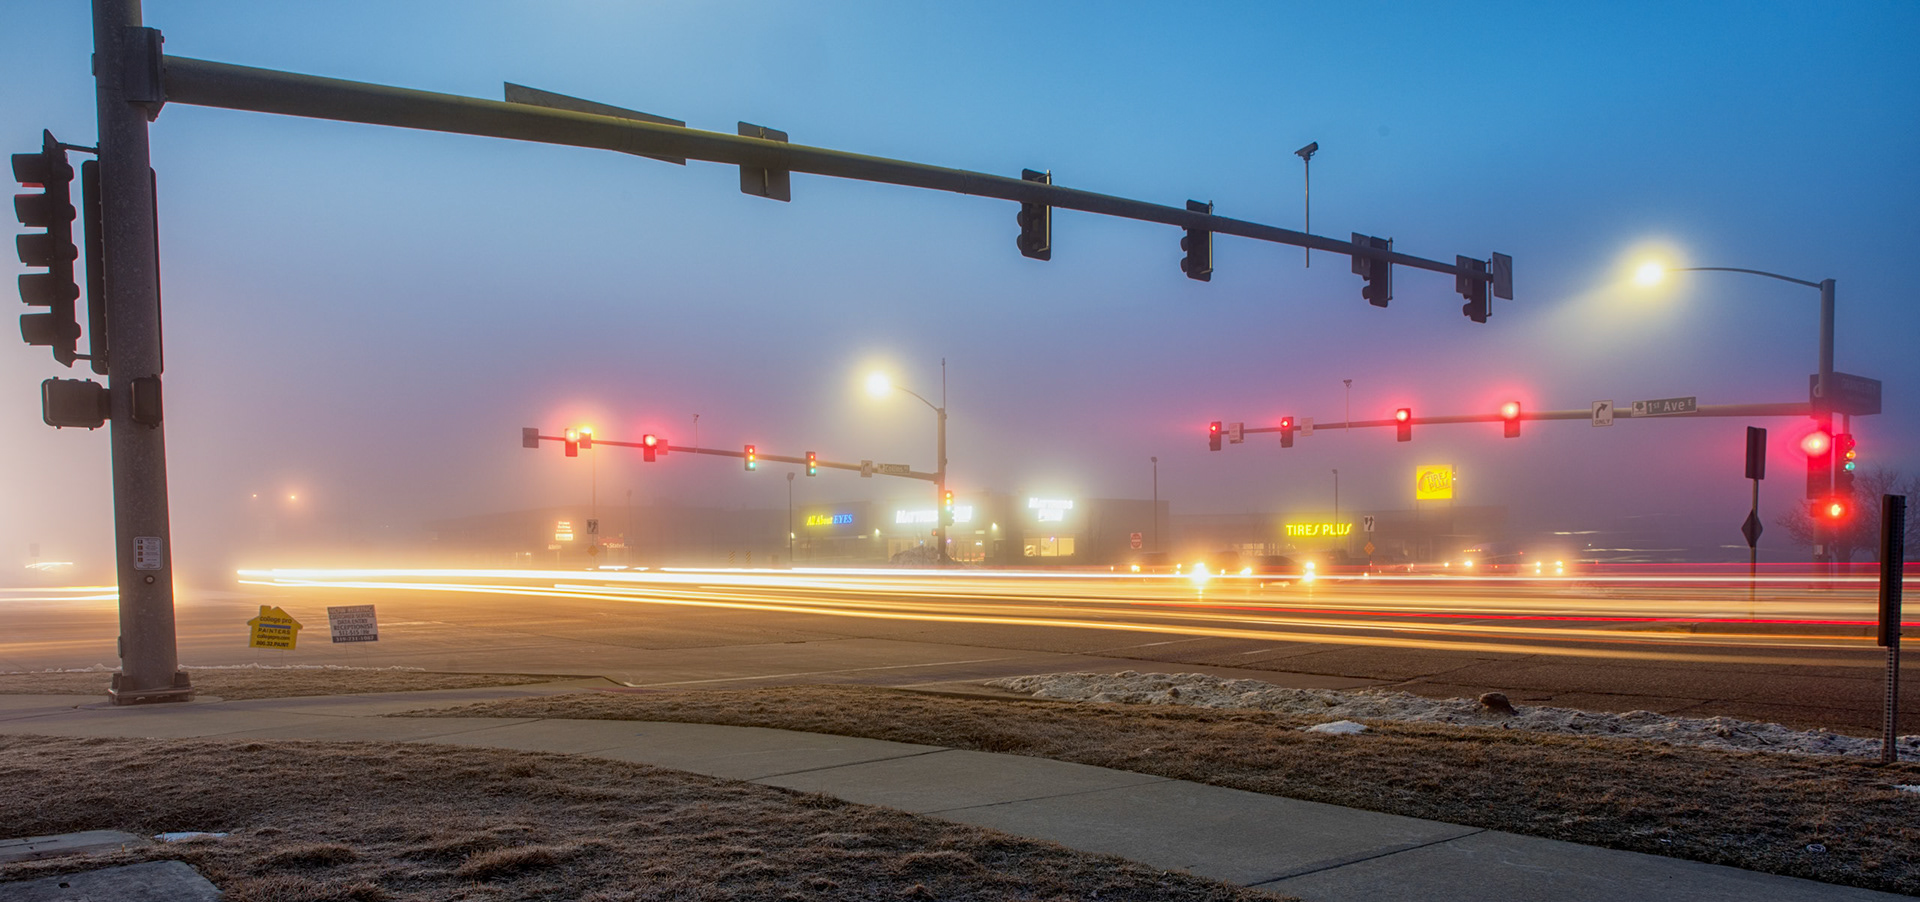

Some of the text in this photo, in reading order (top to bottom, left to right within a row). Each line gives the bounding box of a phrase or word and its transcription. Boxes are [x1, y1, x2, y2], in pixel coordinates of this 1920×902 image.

[1648, 401, 1660, 413] 1st
[1664, 401, 1685, 412] Ave
[1425, 471, 1449, 483] TIRES
[834, 514, 853, 524] EYES
[1286, 523, 1352, 536] TIRES PLUS
[260, 616, 281, 624] college
